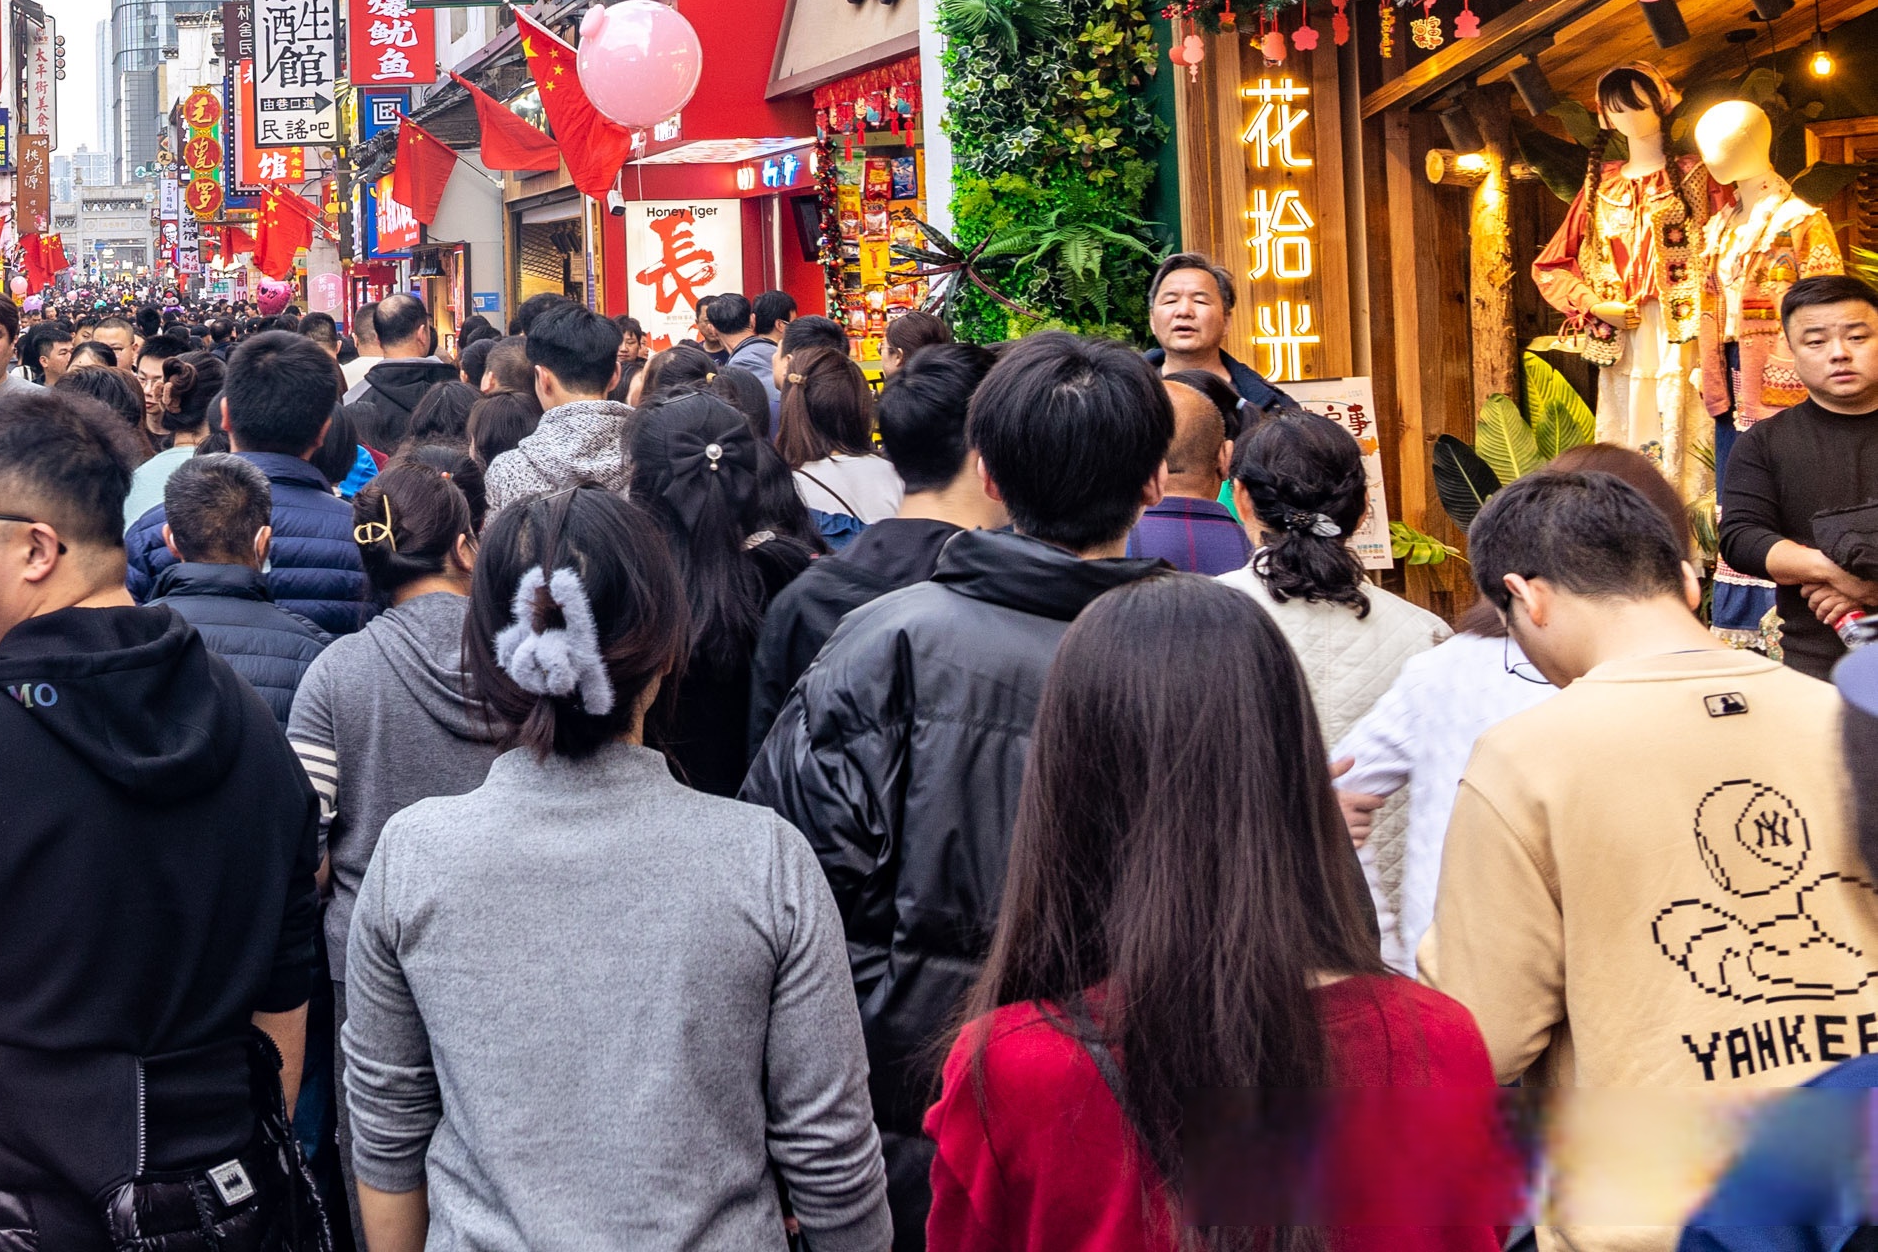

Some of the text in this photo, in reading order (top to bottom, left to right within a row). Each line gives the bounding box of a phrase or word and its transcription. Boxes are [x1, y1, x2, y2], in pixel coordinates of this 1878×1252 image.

[237, 4, 253, 61] 朴舍民
[646, 205, 718, 219] Honey Tiger
[1242, 78, 1320, 382] 花拾光
